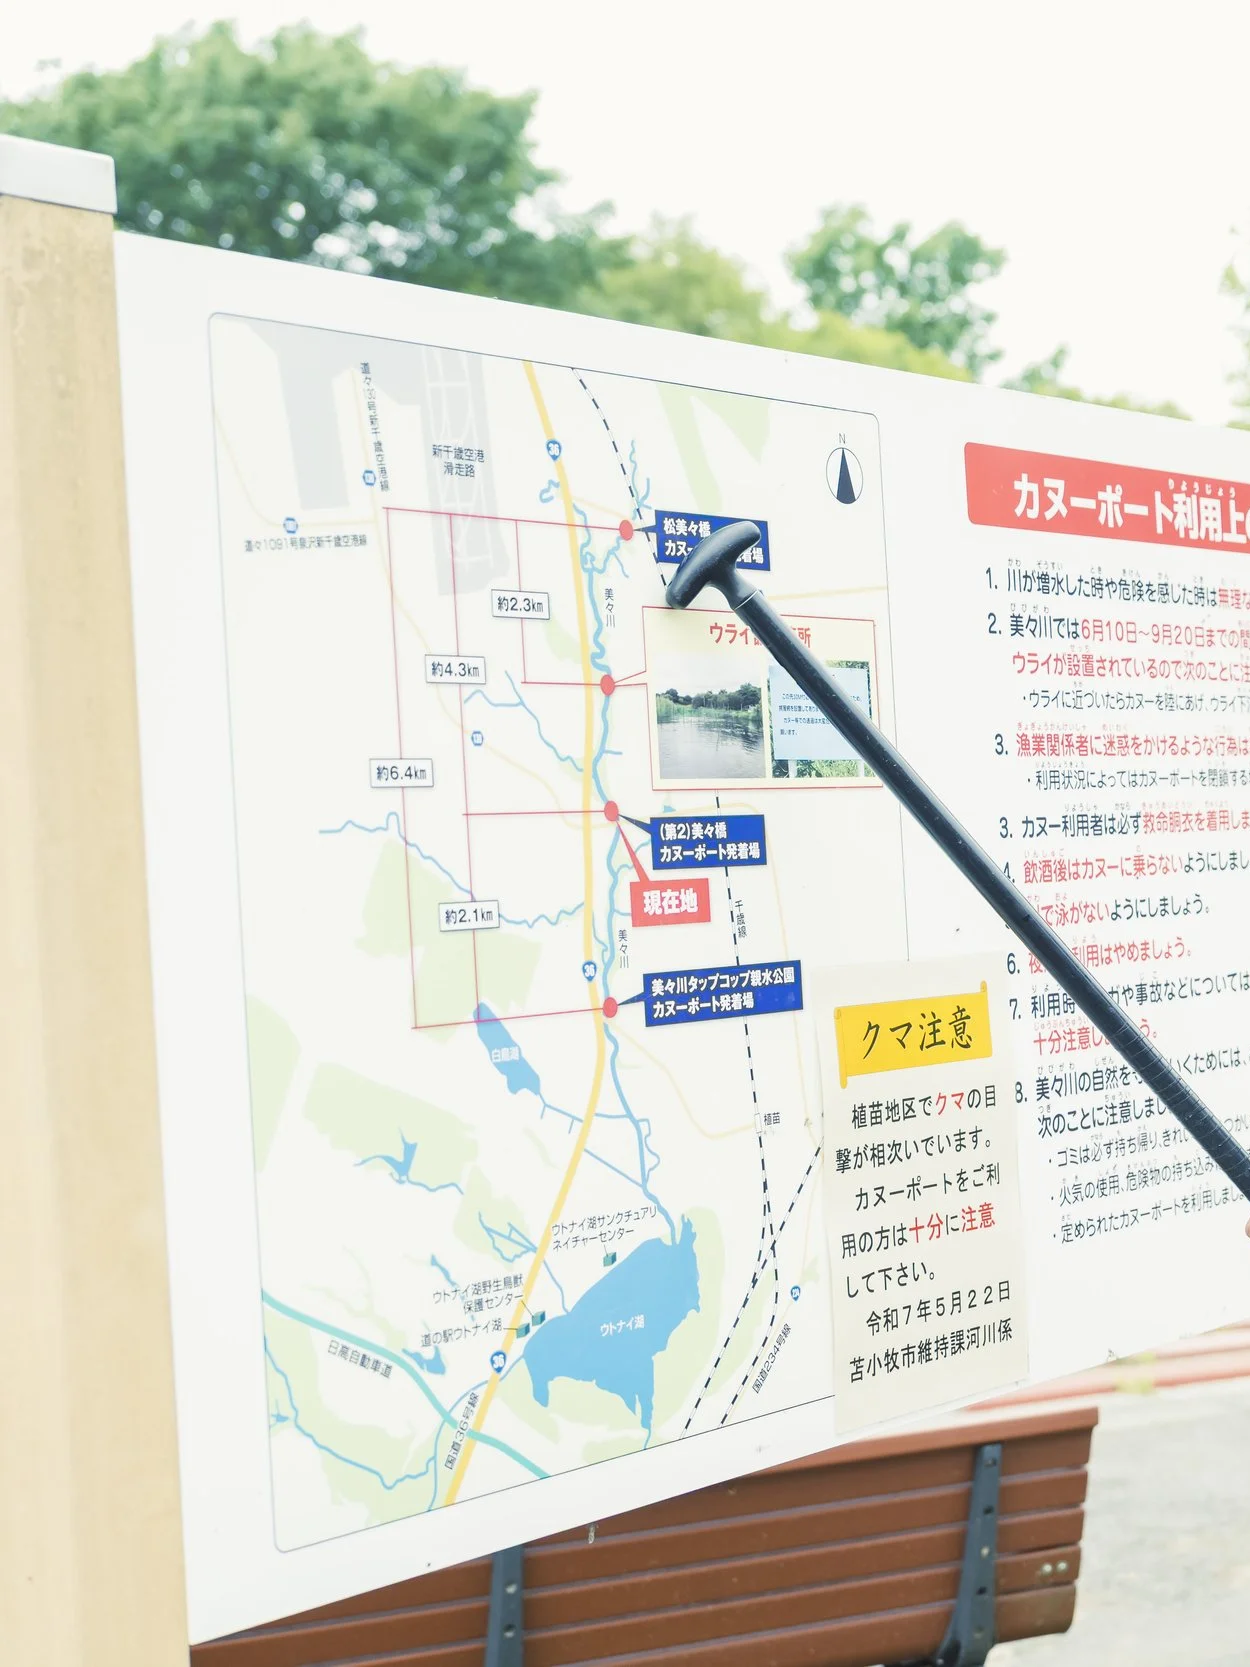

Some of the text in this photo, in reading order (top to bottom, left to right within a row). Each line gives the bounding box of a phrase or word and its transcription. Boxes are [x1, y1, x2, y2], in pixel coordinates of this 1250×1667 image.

[838, 433, 846, 444] N
[432, 444, 485, 463] 新千歳空港
[443, 462, 476, 478] 滑走路
[663, 517, 711, 538] 松美々橋
[986, 567, 998, 589] 1.
[497, 596, 544, 613] 約2.3km
[604, 588, 616, 628] 美々川
[988, 612, 1001, 635] 2.
[431, 661, 480, 678] 約4.3km
[995, 733, 1008, 755] 3.
[376, 766, 427, 781] 約6.4km
[1000, 817, 1013, 838] 3.
[660, 842, 761, 862] カヌーポート発着場
[643, 888, 698, 915] 現在地
[1036, 894, 1210, 927] で泳がないようにしましょう。
[445, 907, 494, 925] 約2.1km
[734, 900, 747, 938] 千歳線
[618, 929, 629, 969] 美々川
[584, 964, 595, 977] 36
[1007, 953, 1020, 974] 6.
[652, 966, 796, 996] 美々川タップコップ親水公園
[653, 992, 755, 1018] カヌーポート発着場
[1009, 999, 1021, 1019] 7.
[862, 1004, 973, 1060] クマ注意
[1015, 1081, 1027, 1103] 8.
[763, 1112, 781, 1126] 植苗
[851, 1084, 997, 1129] 植苗地区でクマの目
[836, 1126, 992, 1173] 撃が相次いでいます。
[855, 1163, 1000, 1211] カヌーポートをご利
[551, 1206, 657, 1236] ウトナイ湖サンクチュアリ
[841, 1202, 996, 1259] 用の方は十分に注意
[553, 1228, 635, 1252] ネイチャーセンター
[433, 1273, 524, 1304] ウトナイ湖野生鳥獣
[846, 1260, 936, 1298] して下さい。
[463, 1293, 524, 1314] 保護センター
[866, 1280, 1011, 1337] 令和7年5月22日
[421, 1318, 503, 1347] 道の駅ウトナイ湖
[600, 1314, 645, 1337] ウトナイ湖
[328, 1339, 394, 1379] 日高自動車道
[752, 1323, 791, 1394] 国道234号線
[849, 1317, 1014, 1384] 苫小牧市維持課河川係
[445, 1392, 479, 1470] 国道36号線
